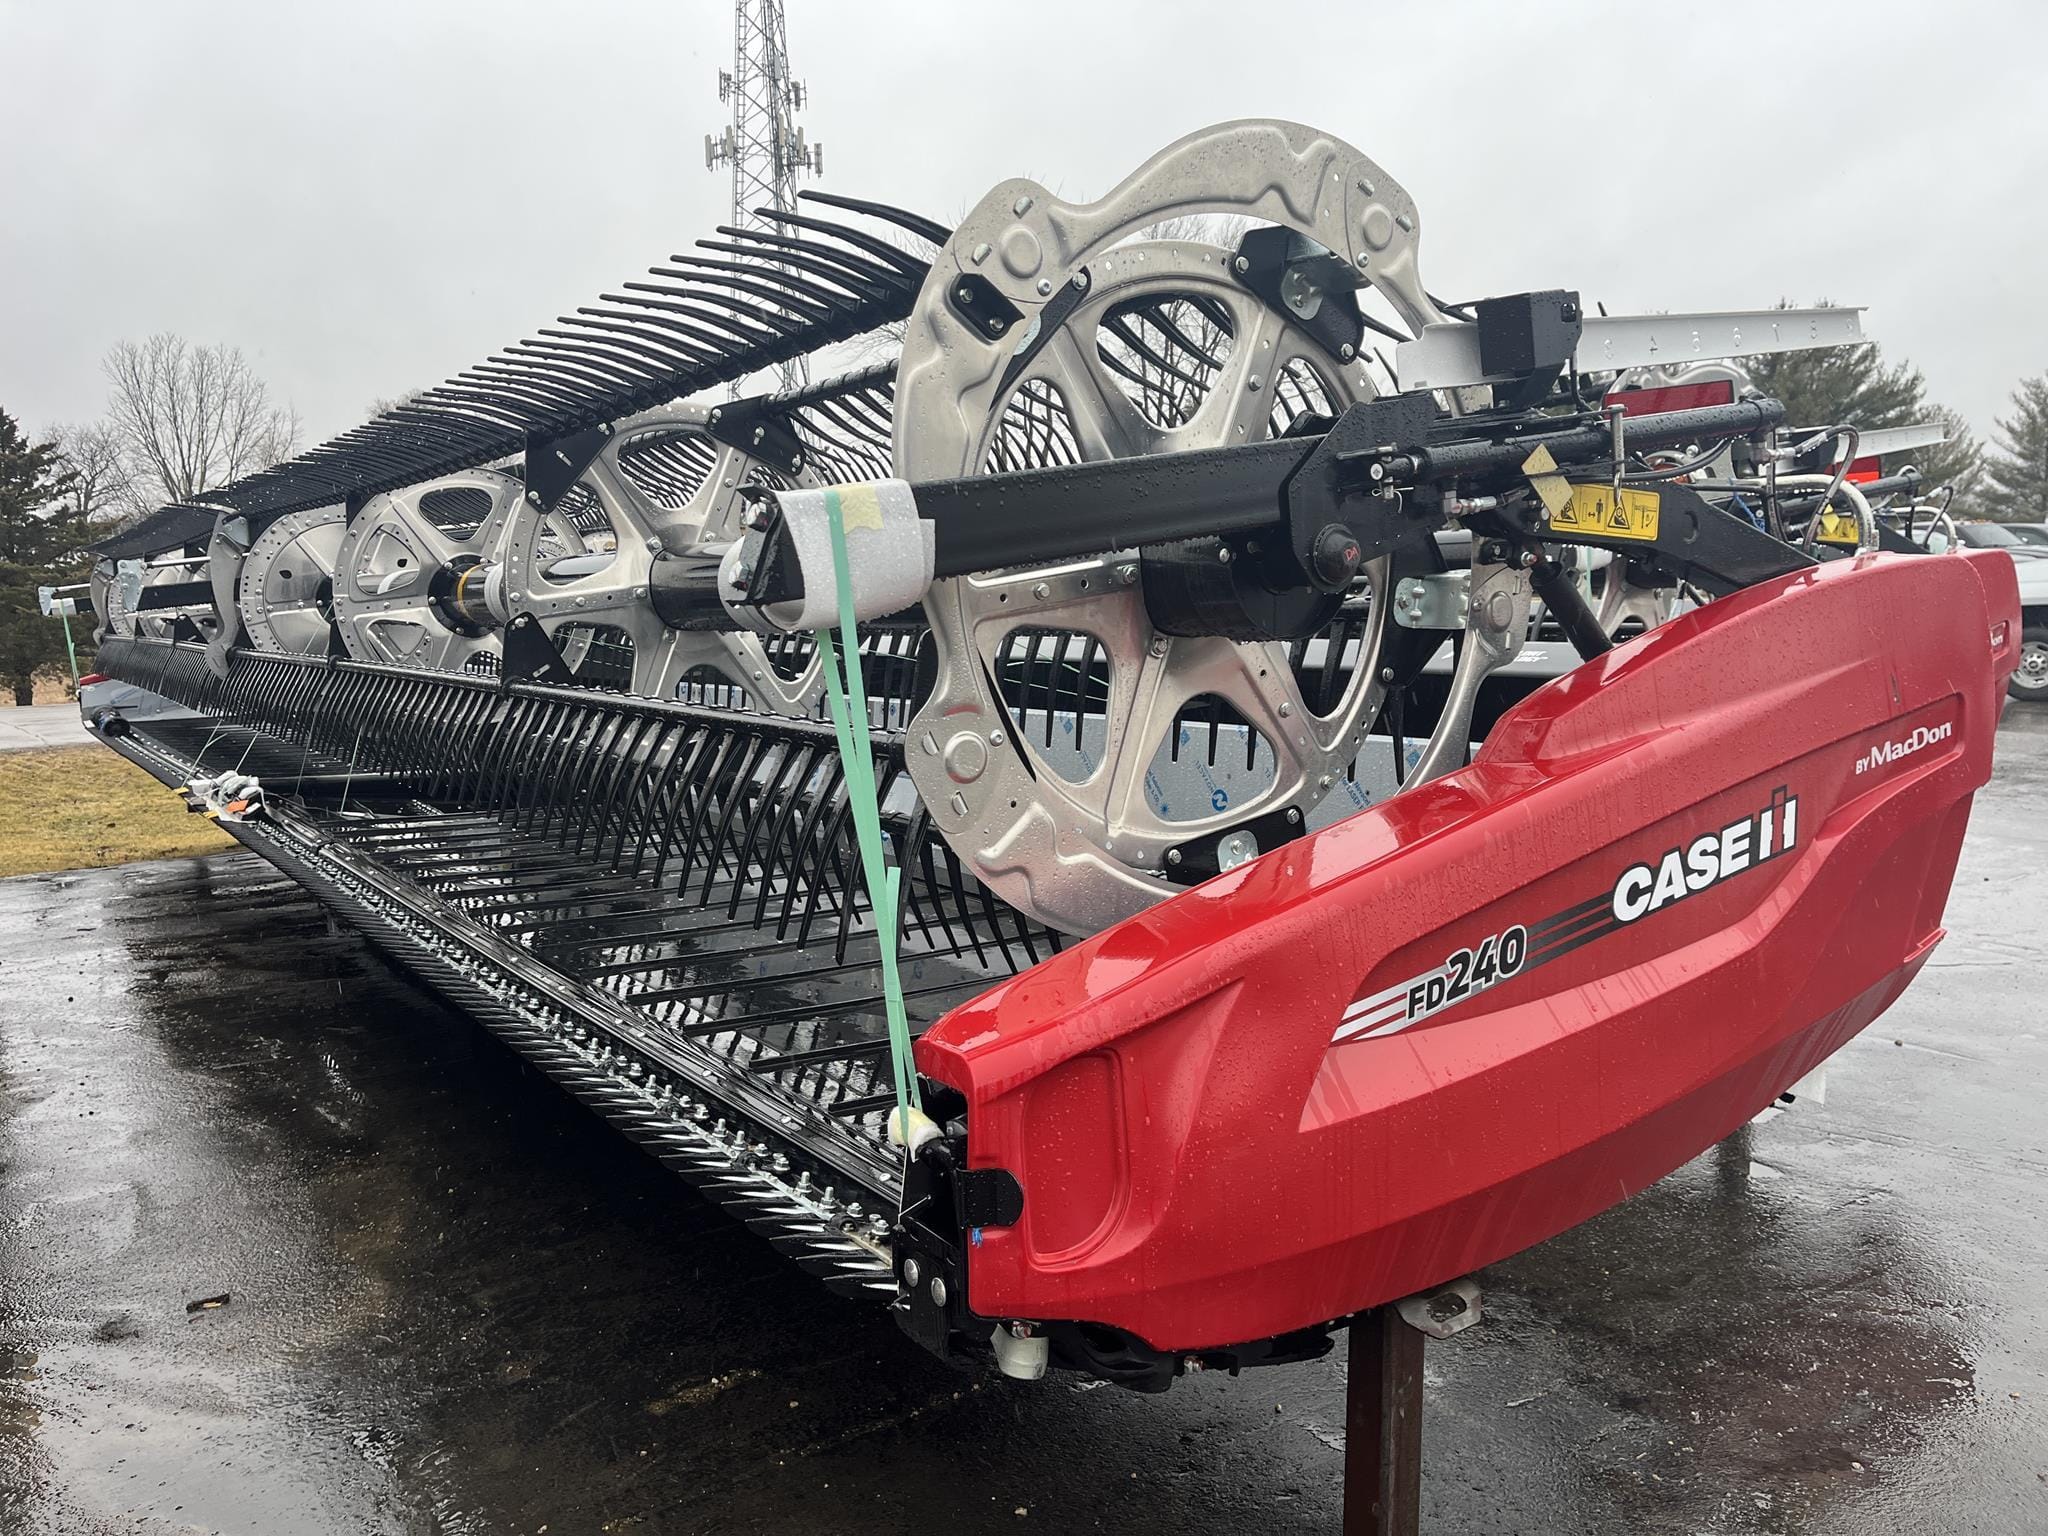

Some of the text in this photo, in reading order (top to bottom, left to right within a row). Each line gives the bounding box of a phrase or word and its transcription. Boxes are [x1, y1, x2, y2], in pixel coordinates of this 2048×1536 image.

[1856, 721, 1952, 775] BY MacDon
[1612, 816, 1753, 922] CASE
[1406, 925, 1527, 1020] FD240
